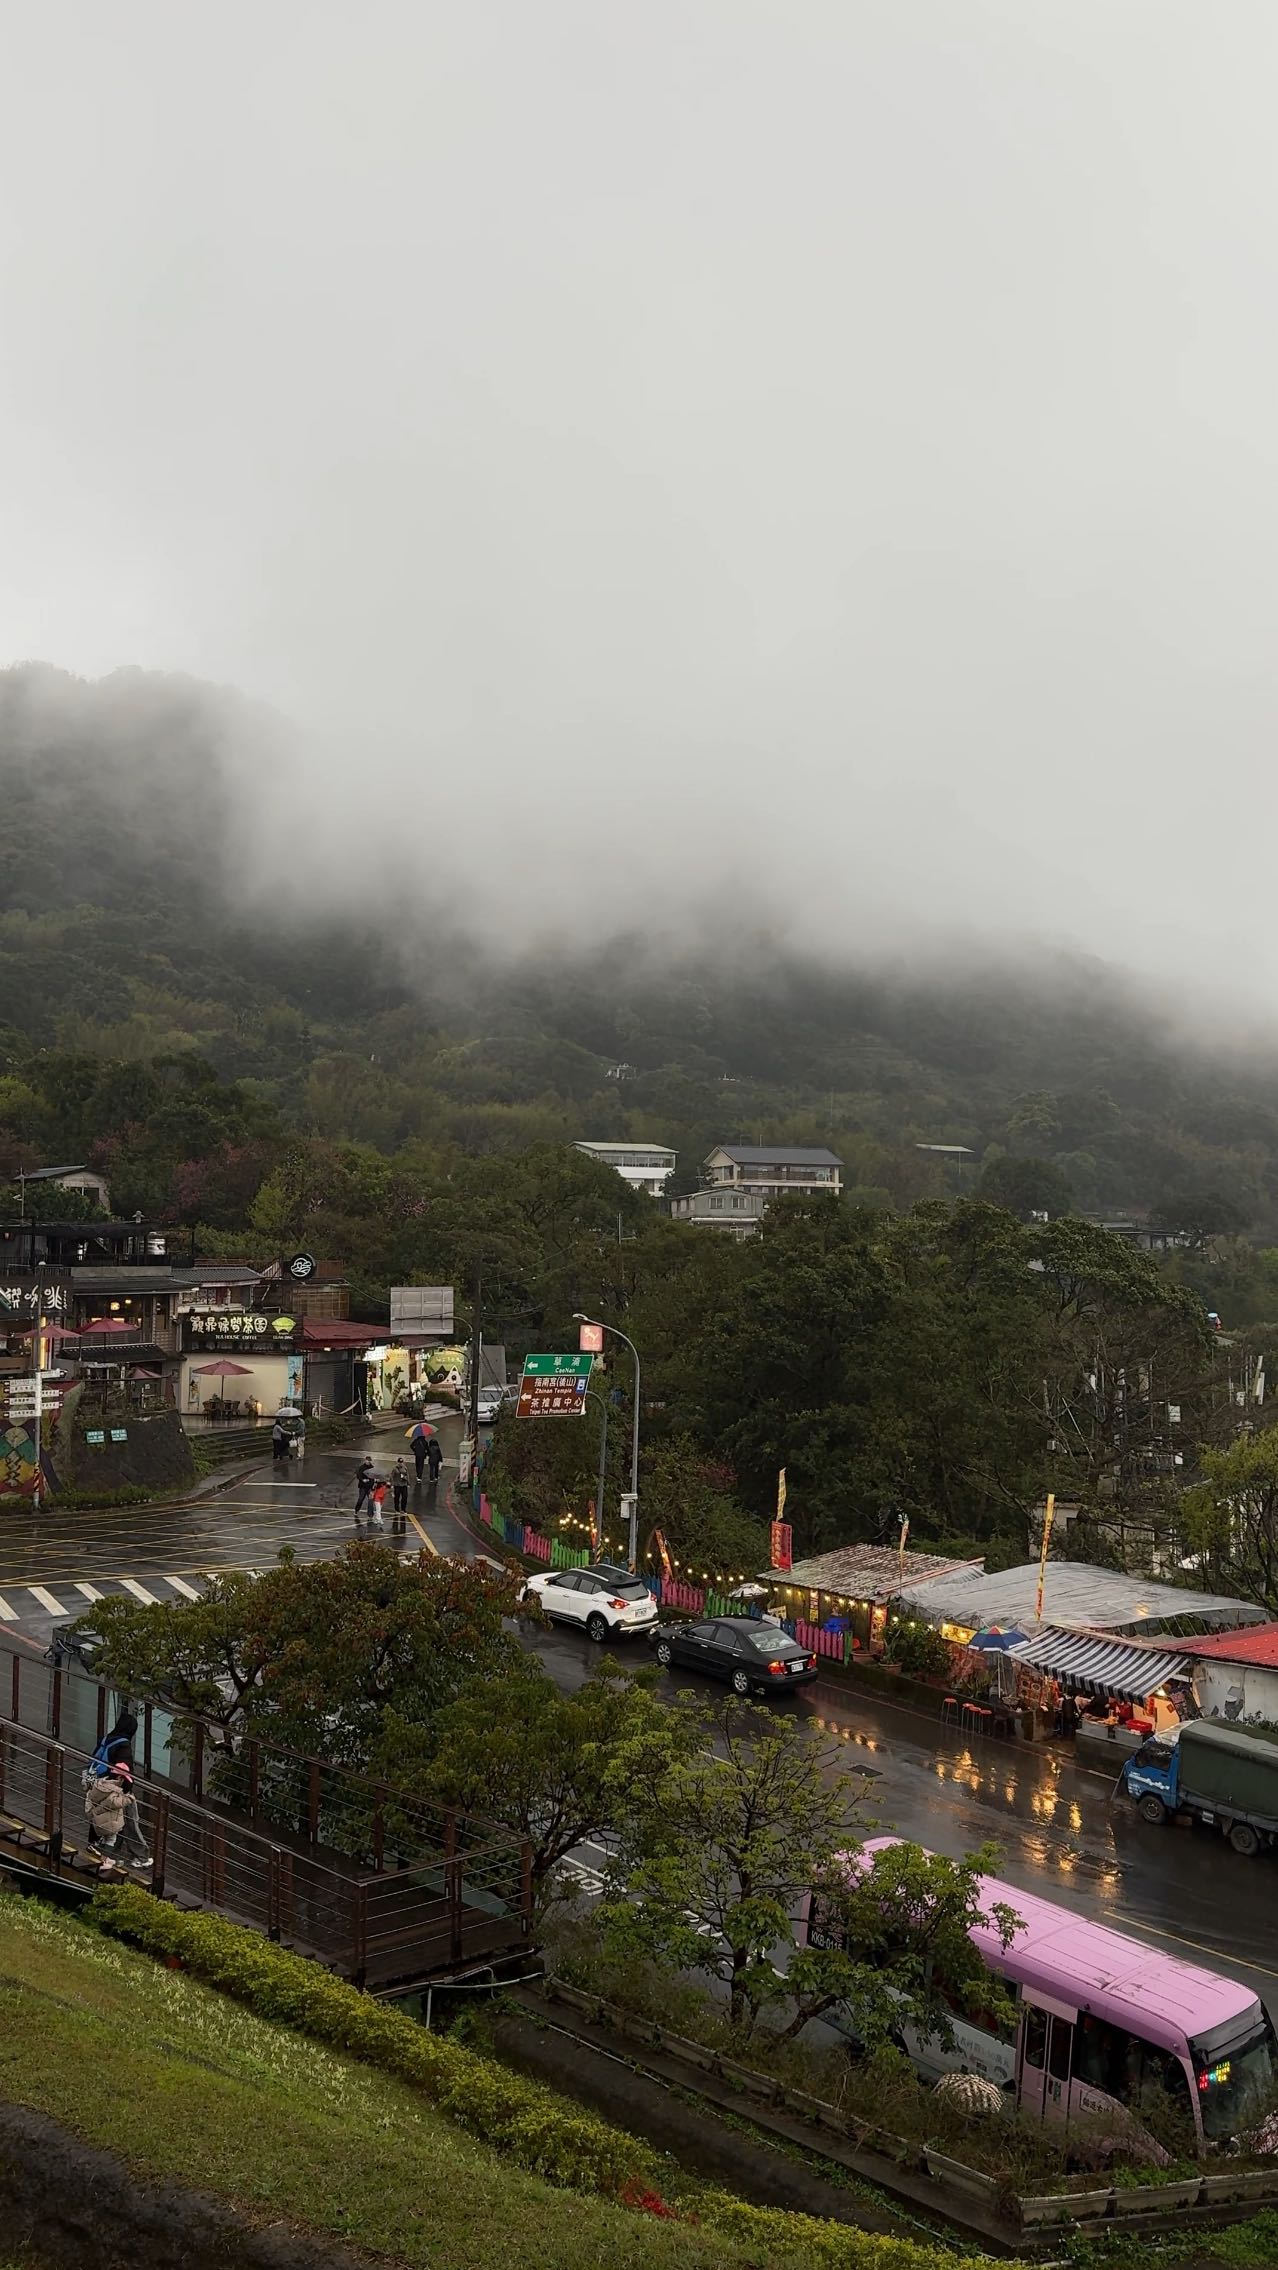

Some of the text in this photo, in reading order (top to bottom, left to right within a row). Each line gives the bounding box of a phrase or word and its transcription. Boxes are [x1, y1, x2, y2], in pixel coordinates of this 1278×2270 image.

[534, 1377, 577, 1387] 指南宮(後山)
[530, 1397, 582, 1408] 茶推廣中心
